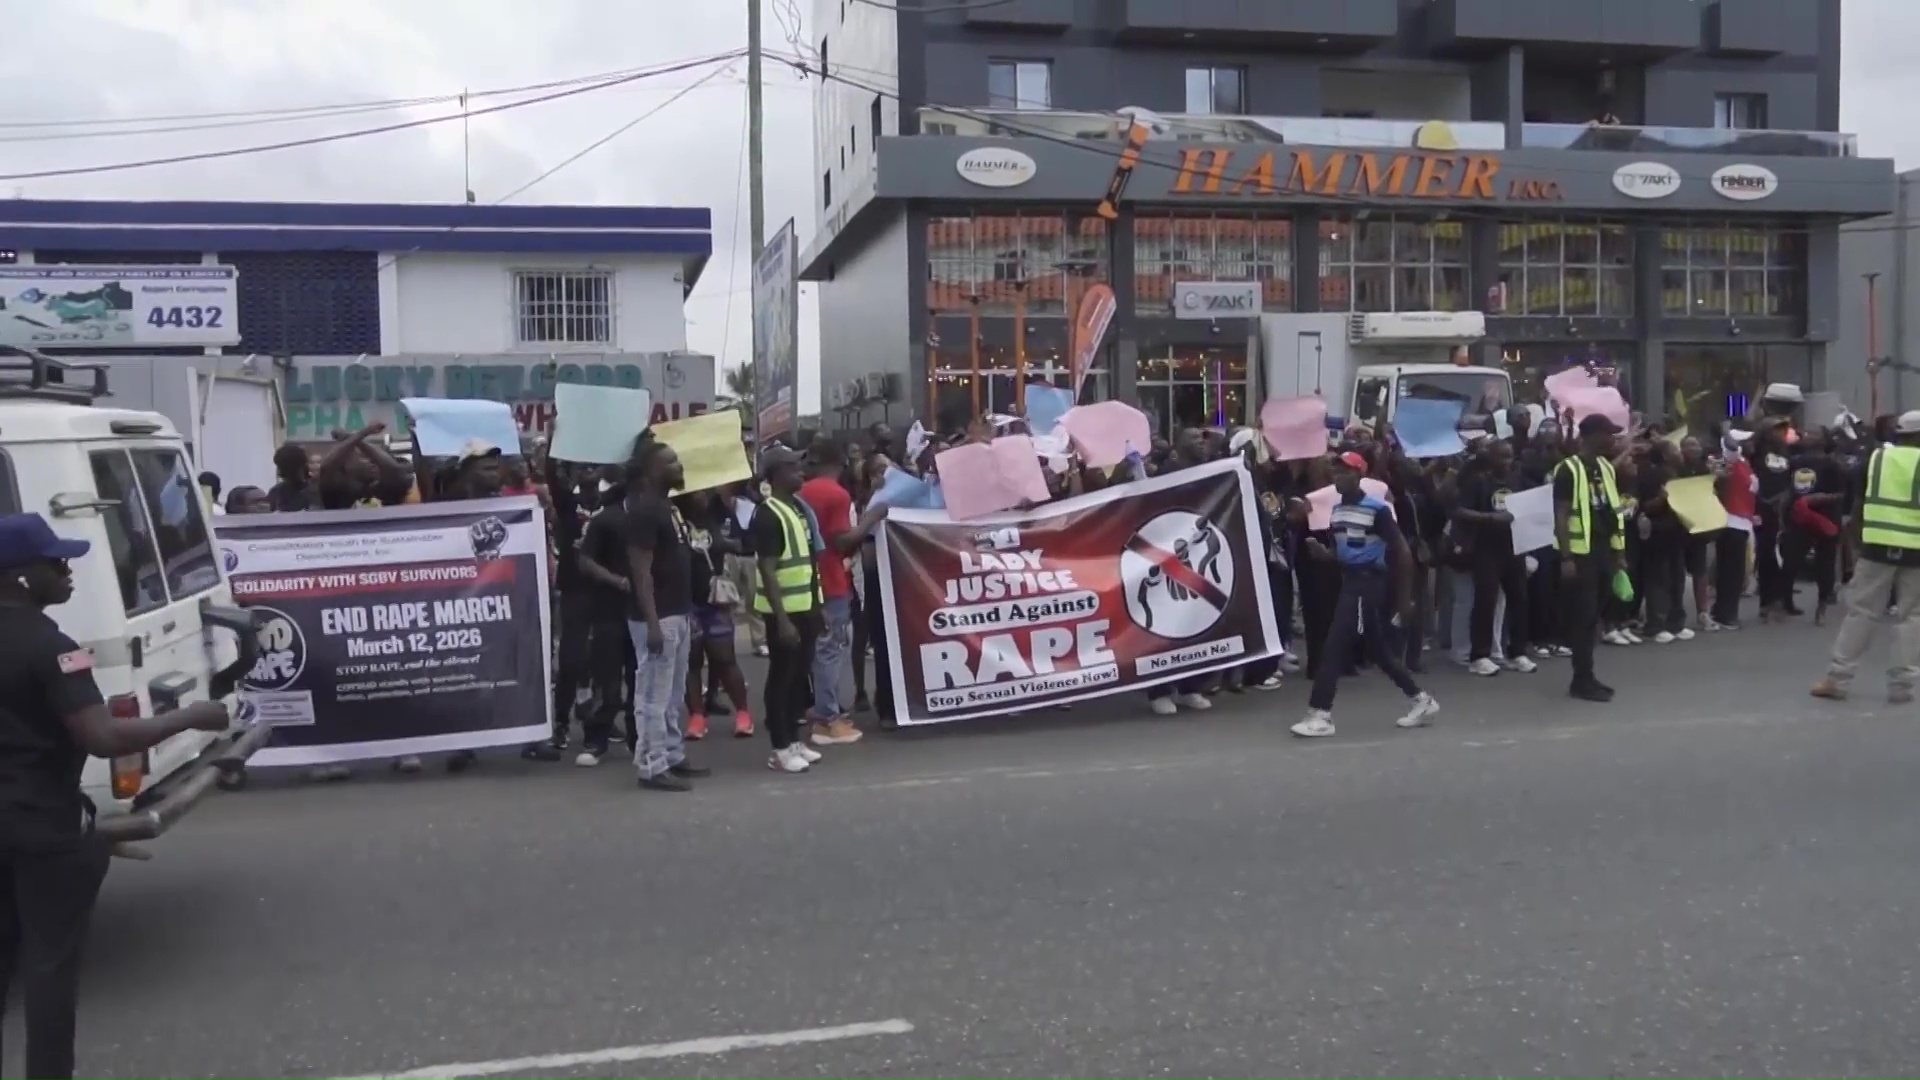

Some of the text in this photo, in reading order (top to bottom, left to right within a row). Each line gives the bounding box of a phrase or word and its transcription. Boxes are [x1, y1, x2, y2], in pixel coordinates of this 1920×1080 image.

[963, 160, 1019, 170] HAMMER
[1169, 147, 1563, 201] HAMMER INC.
[1721, 174, 1766, 190] FINDER
[147, 305, 223, 328] 4432
[287, 364, 434, 402] LUCKY
[960, 549, 1044, 574] LADY
[234, 565, 478, 595] SOLIDARITY WITH SGBV SURVIVORS
[944, 569, 1079, 604] JUSTICE
[320, 594, 512, 635] END RAPE MARCH
[932, 595, 1097, 630] Stand Against
[347, 627, 483, 658] March 12, 2026
[919, 618, 1117, 691] RAPE
[1150, 642, 1231, 670] No Means No!
[335, 664, 369, 676] STOP
[425, 657, 443, 668] the
[929, 667, 1117, 708] Stop Sexual Violence Now!
